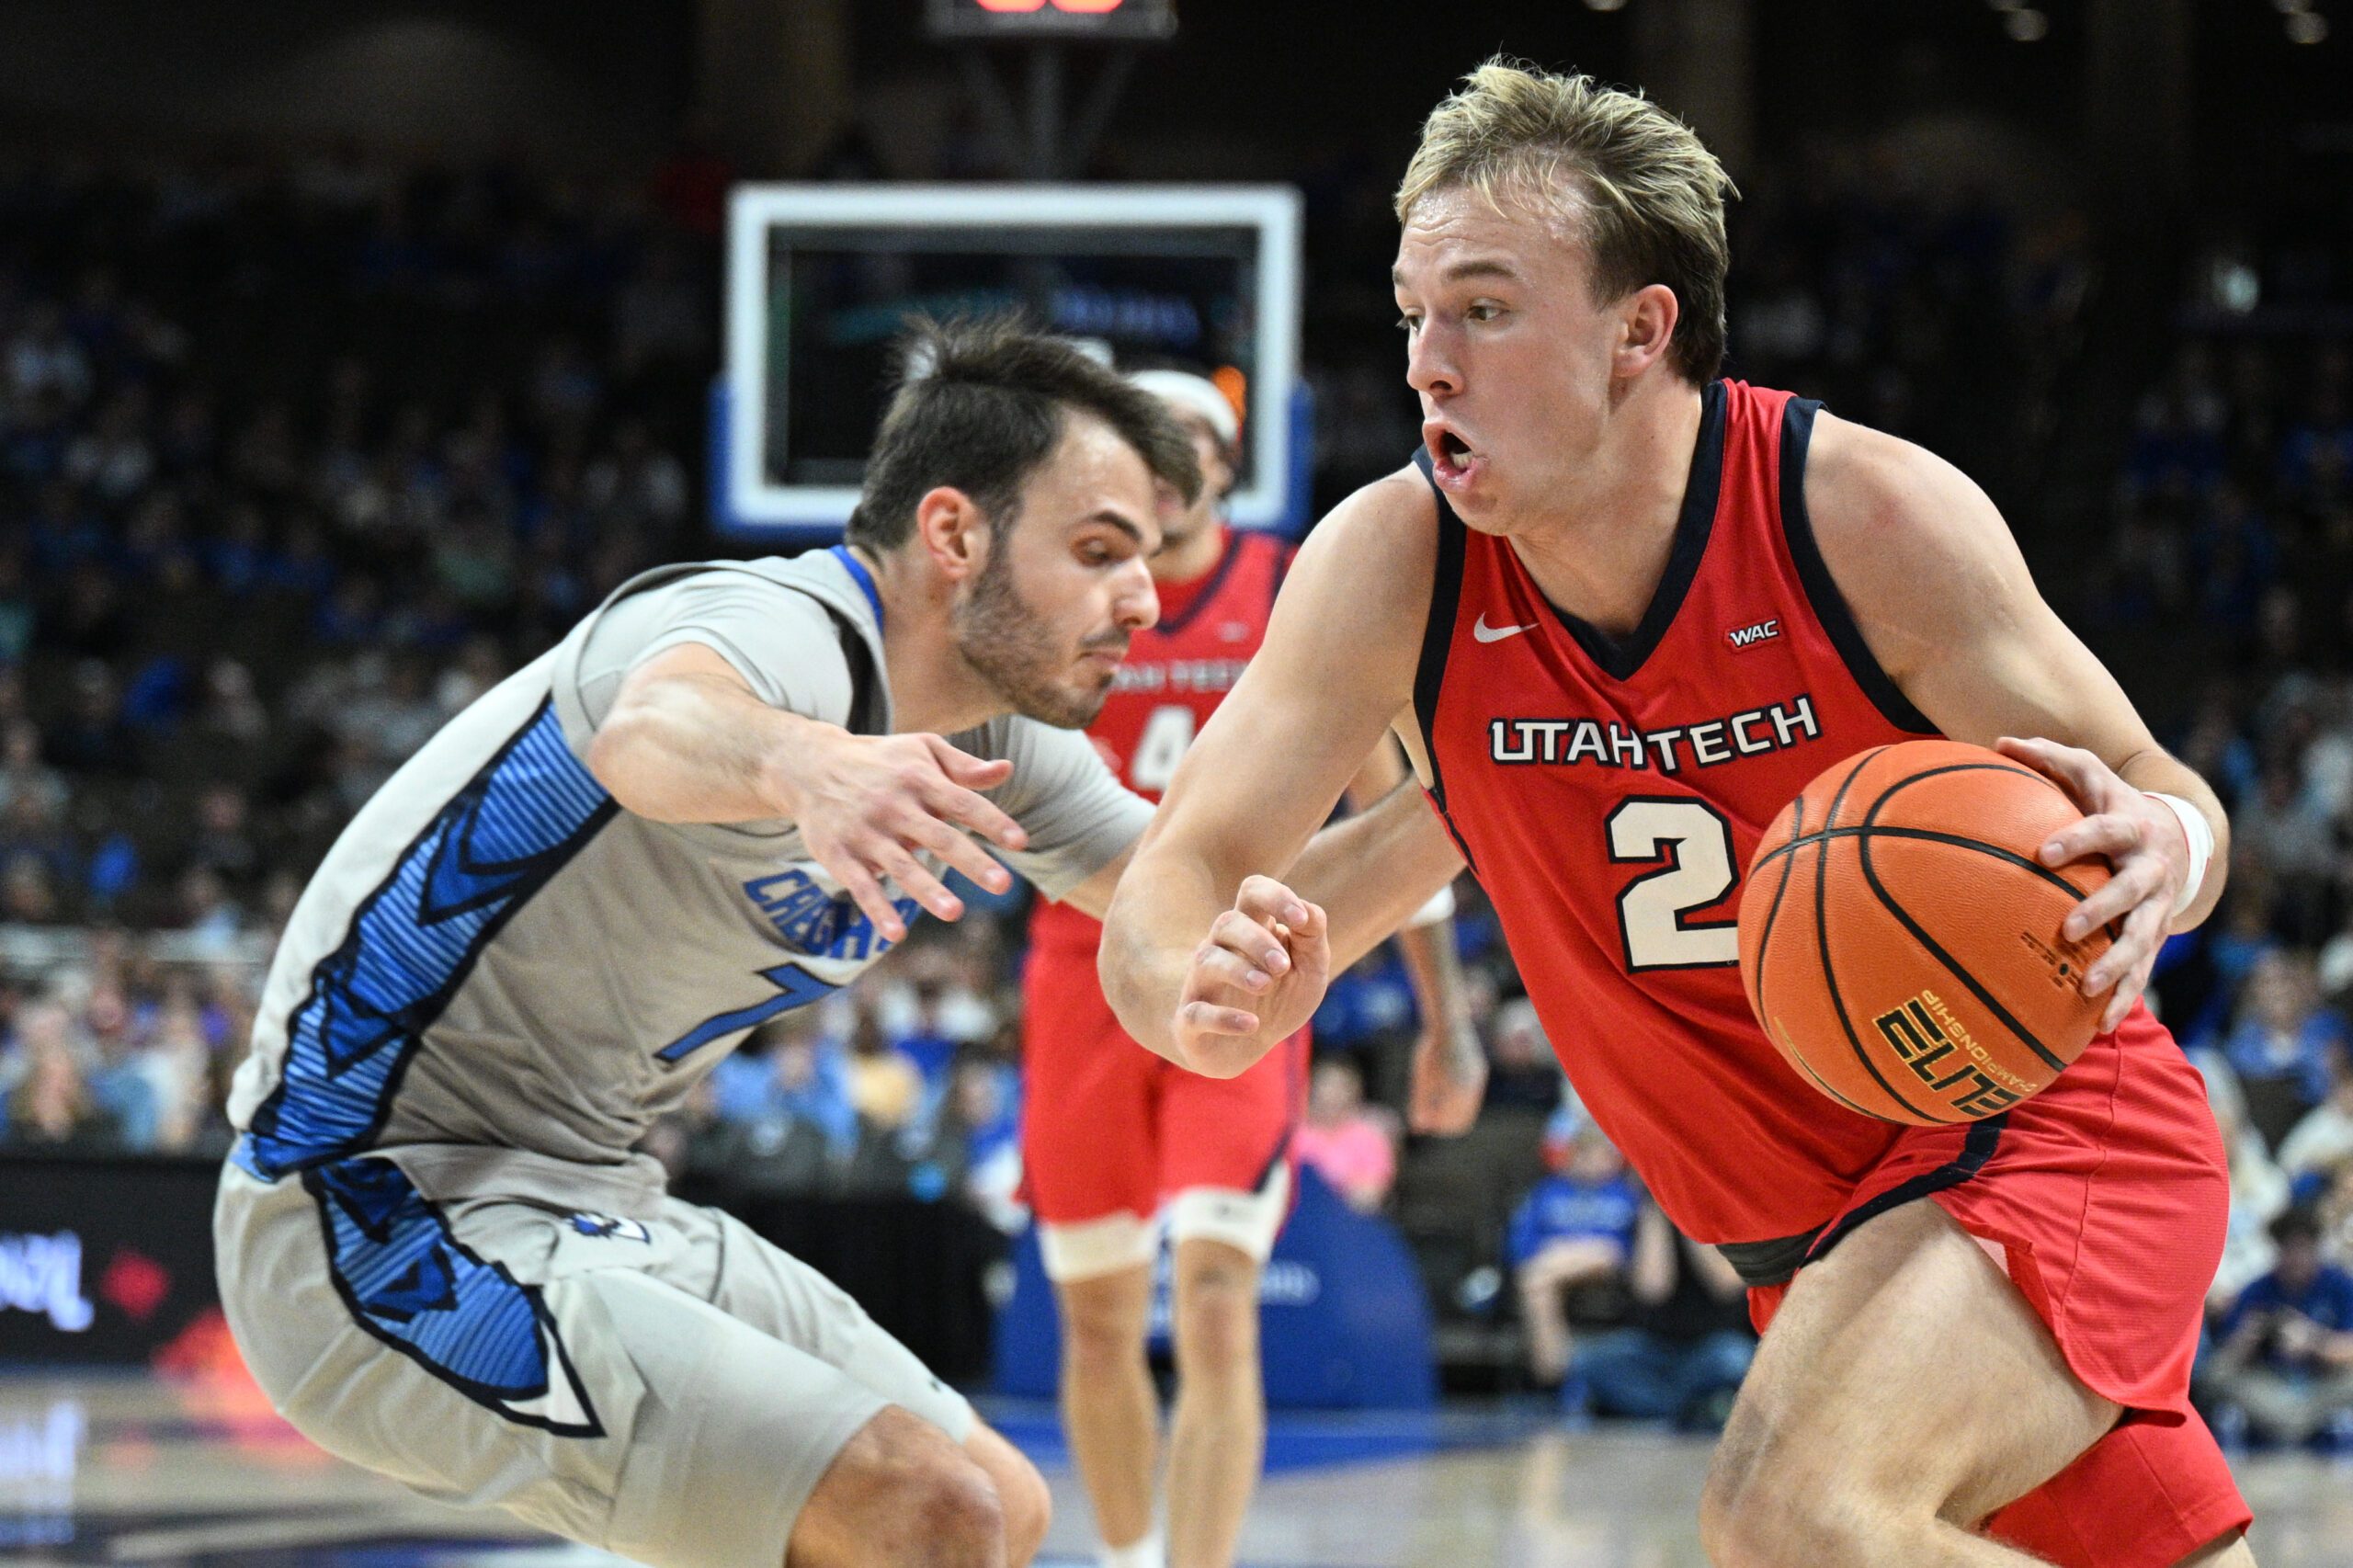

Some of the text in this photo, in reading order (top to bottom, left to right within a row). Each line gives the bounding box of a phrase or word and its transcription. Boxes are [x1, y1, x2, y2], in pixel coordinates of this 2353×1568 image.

[1729, 619, 1779, 647] WAC
[1132, 704, 1197, 789] 4
[1604, 794, 1740, 974] 2
[1872, 995, 2024, 1118] ELITE
[1921, 989, 2039, 1093] CHAMPIONSHIP
